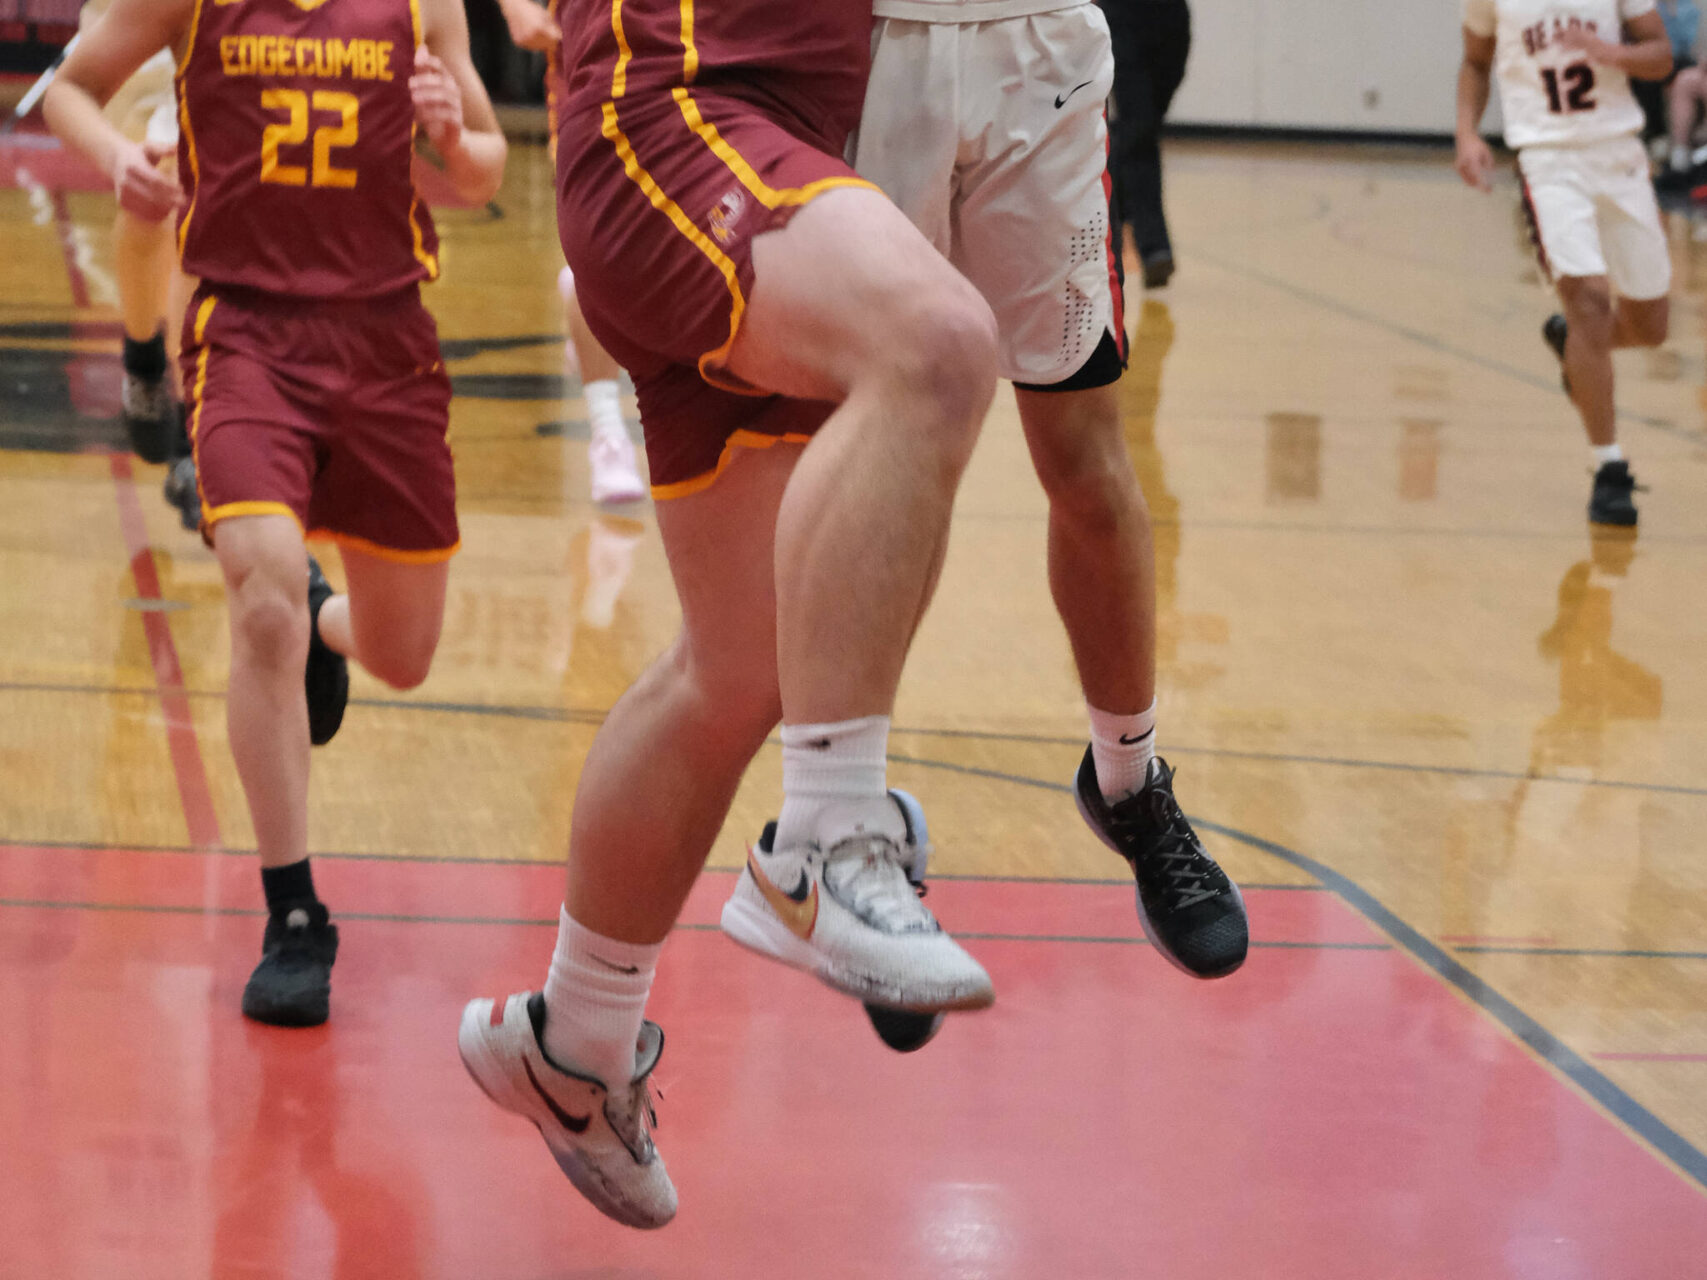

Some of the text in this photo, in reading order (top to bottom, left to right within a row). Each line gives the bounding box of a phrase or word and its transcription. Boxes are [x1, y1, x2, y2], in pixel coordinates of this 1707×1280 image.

[219, 35, 394, 81] EDGECUMBE
[1540, 61, 1597, 114] 12
[260, 88, 359, 188] 22
